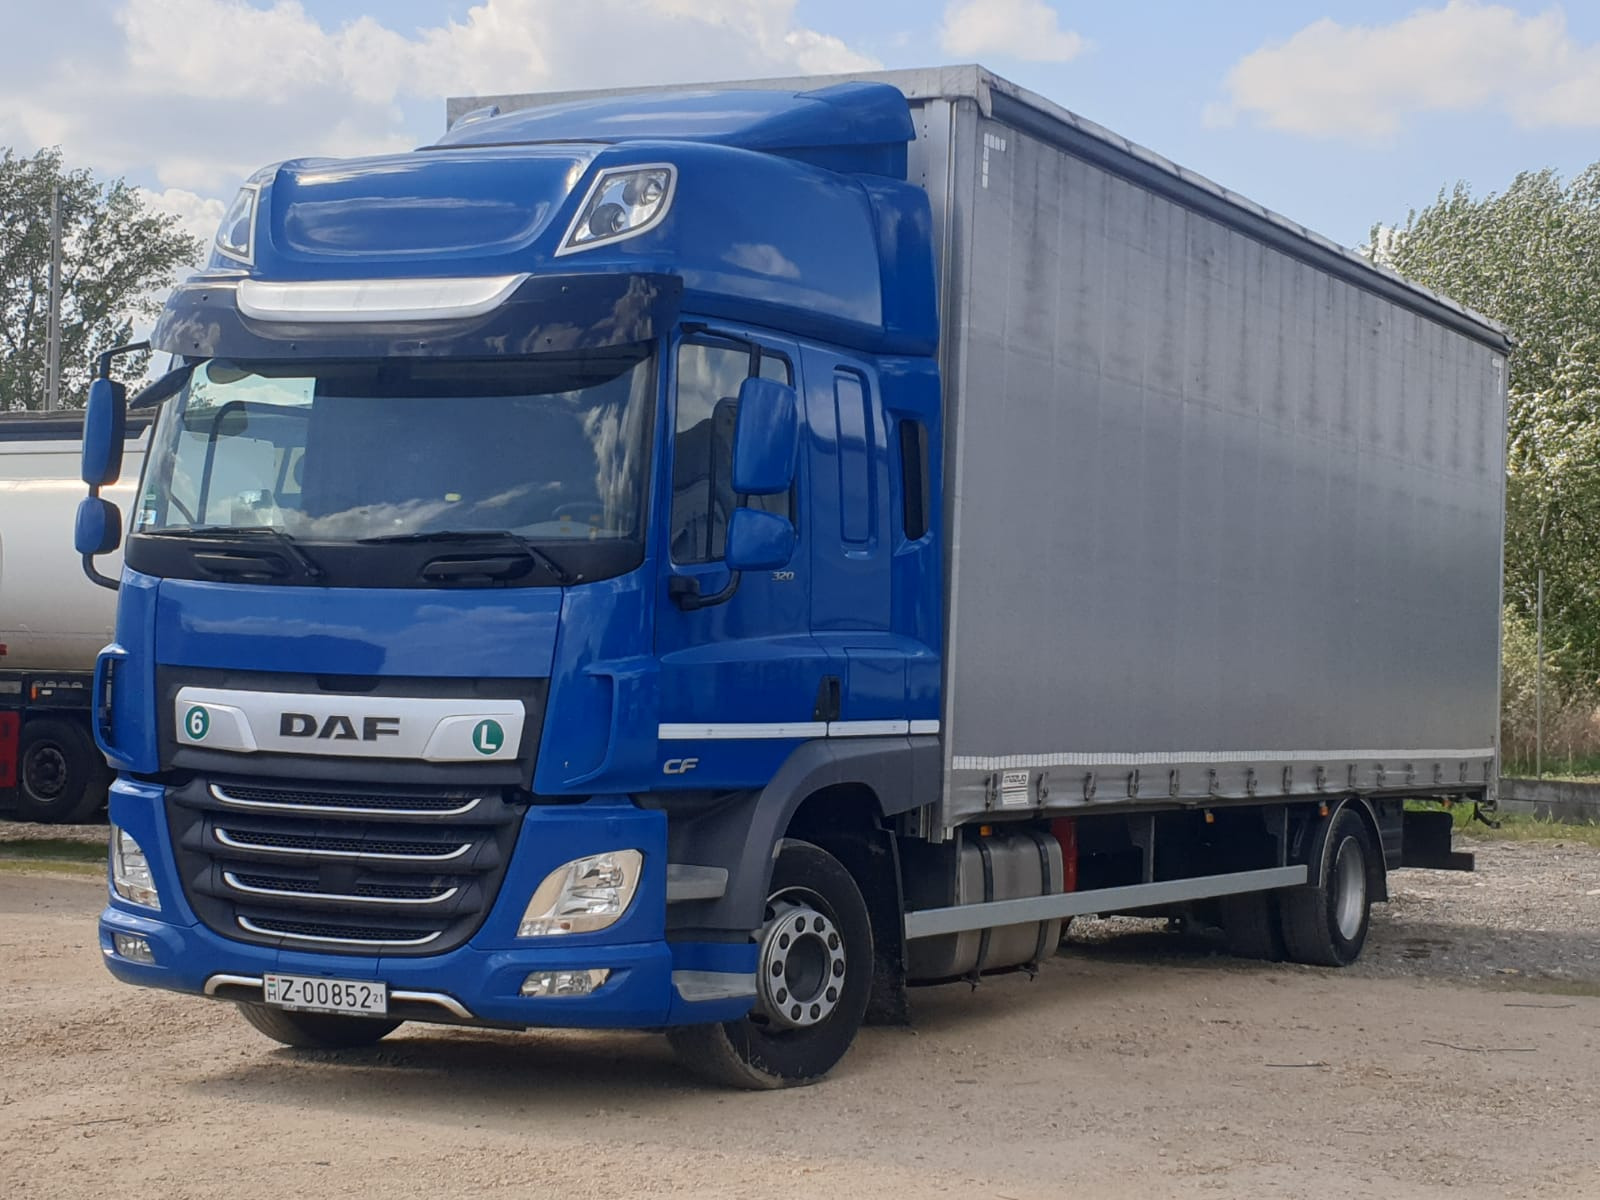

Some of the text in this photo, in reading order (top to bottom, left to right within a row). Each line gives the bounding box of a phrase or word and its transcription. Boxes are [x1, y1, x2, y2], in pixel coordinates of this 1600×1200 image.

[772, 571, 795, 581] 320
[191, 711, 204, 734] 6
[279, 713, 401, 741] DAF
[480, 724, 497, 750] L
[663, 757, 699, 774] CF
[267, 989, 277, 1001] H
[280, 979, 372, 1009] Z-00852
